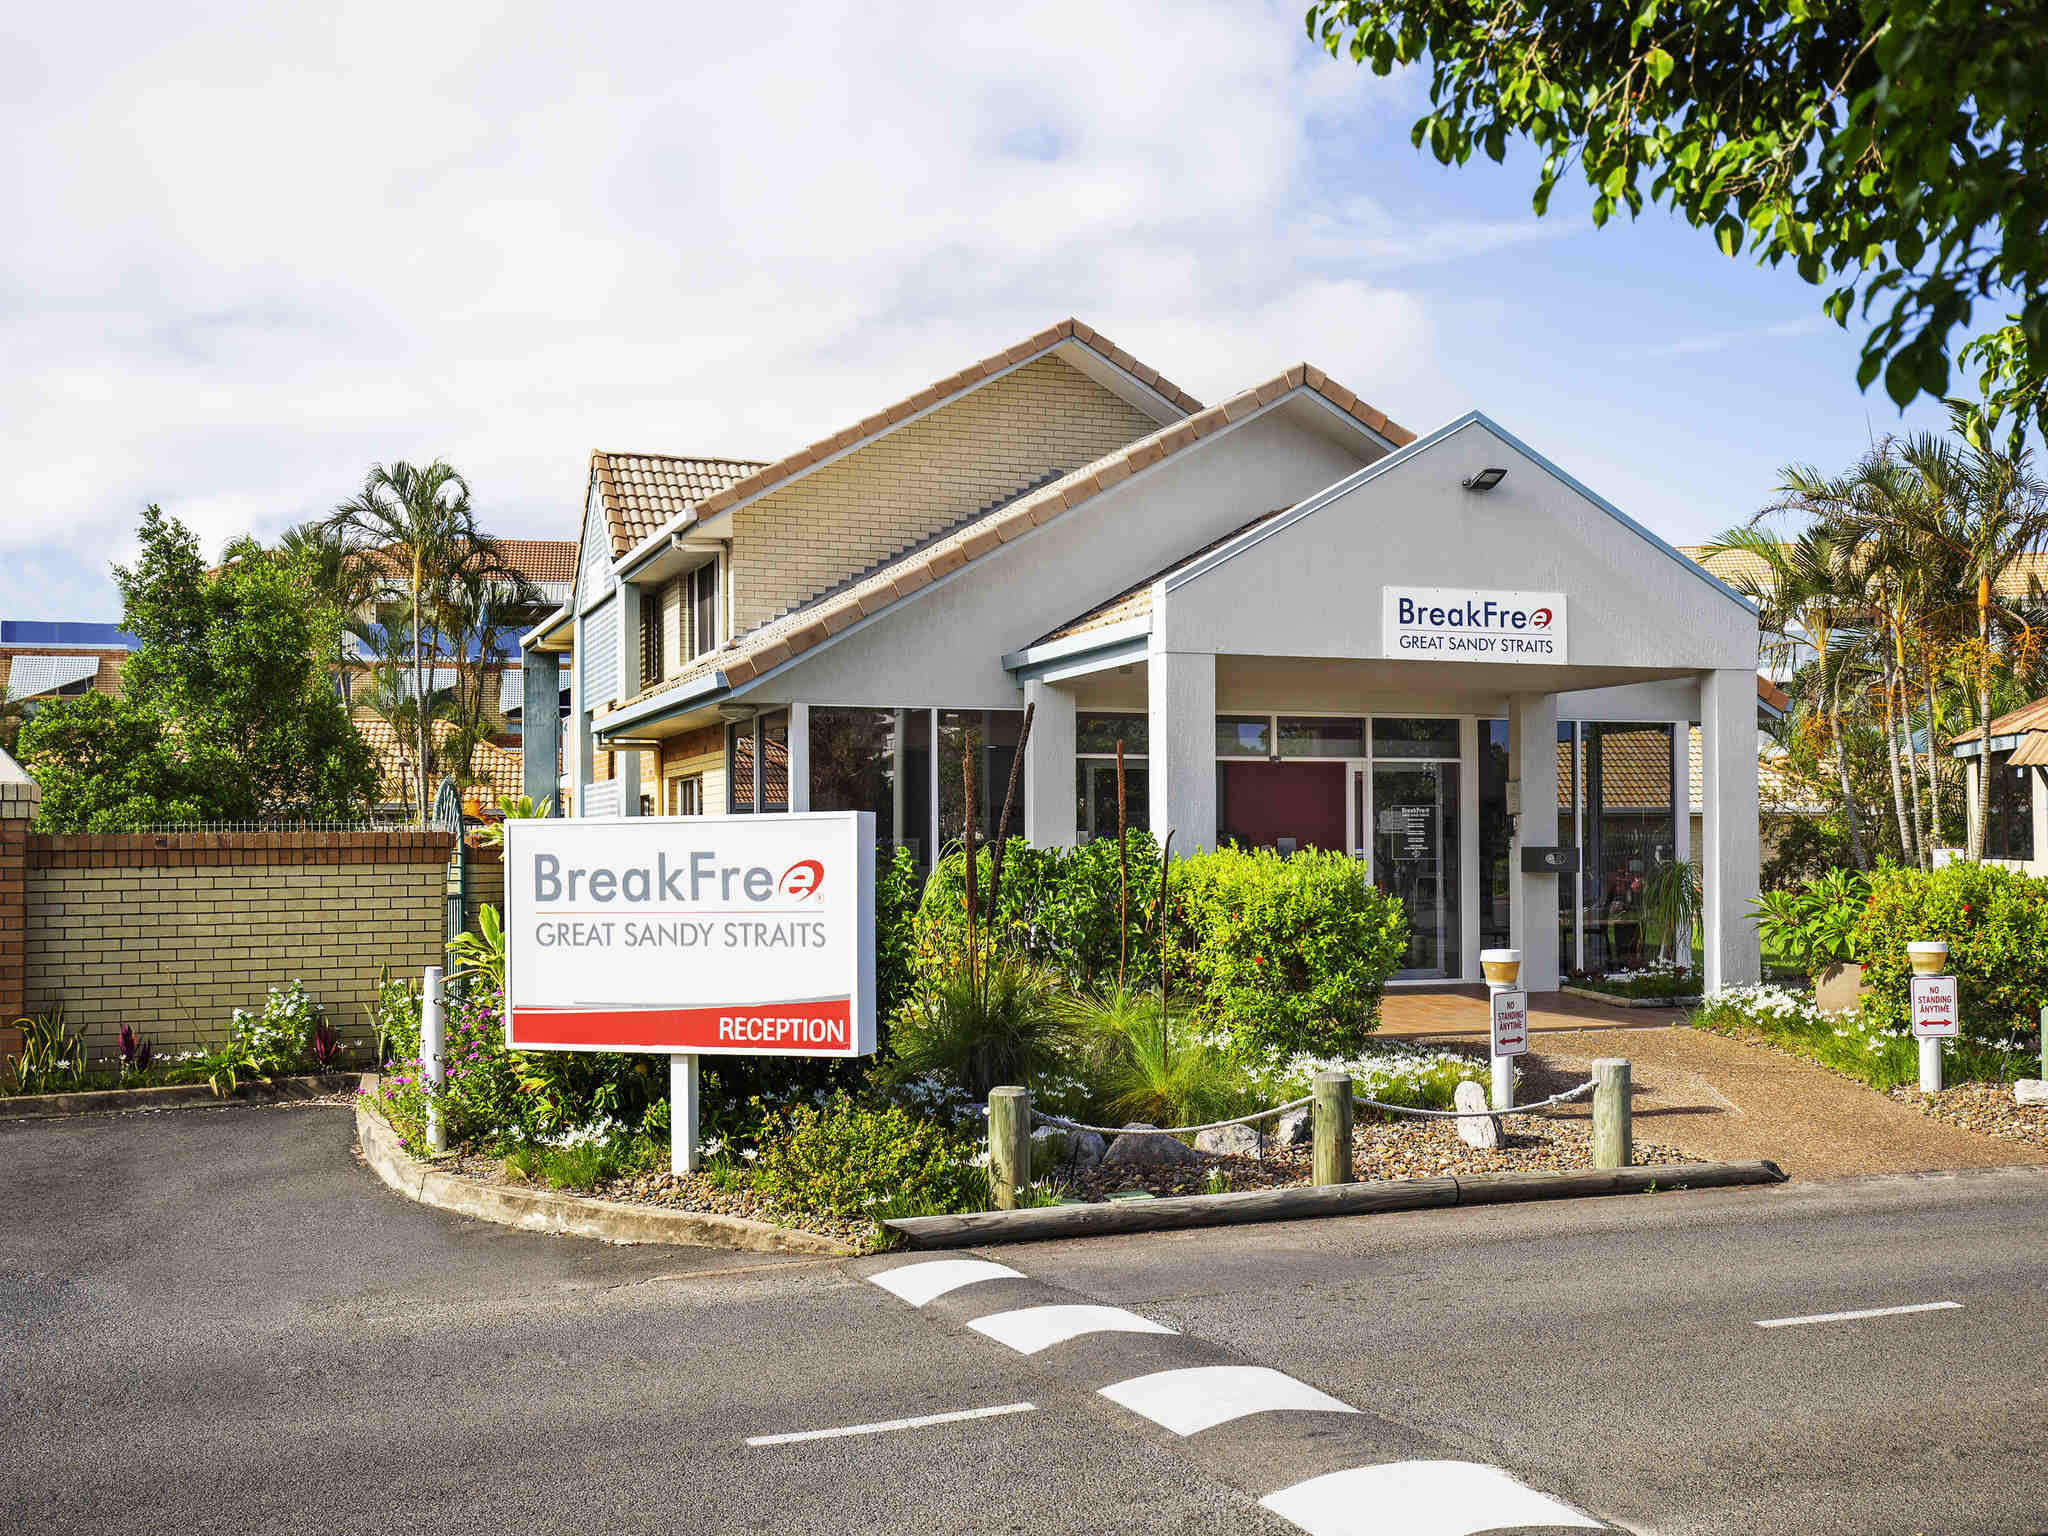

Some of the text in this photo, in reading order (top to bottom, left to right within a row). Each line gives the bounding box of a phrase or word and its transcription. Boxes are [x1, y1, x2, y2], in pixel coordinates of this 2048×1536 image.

[1399, 597, 1553, 630] BreakFree
[1400, 634, 1553, 654] GREAT SANDY STRAITS
[534, 851, 825, 902] BreakFree
[535, 922, 826, 948] GREAT SANDY STRAITS
[1918, 995, 1952, 1004] STANDING
[1929, 986, 1940, 994] NO
[1506, 1000, 1515, 1009] NO
[1919, 1005, 1951, 1014] ANYTIME
[718, 1016, 845, 1043] RECEPTION
